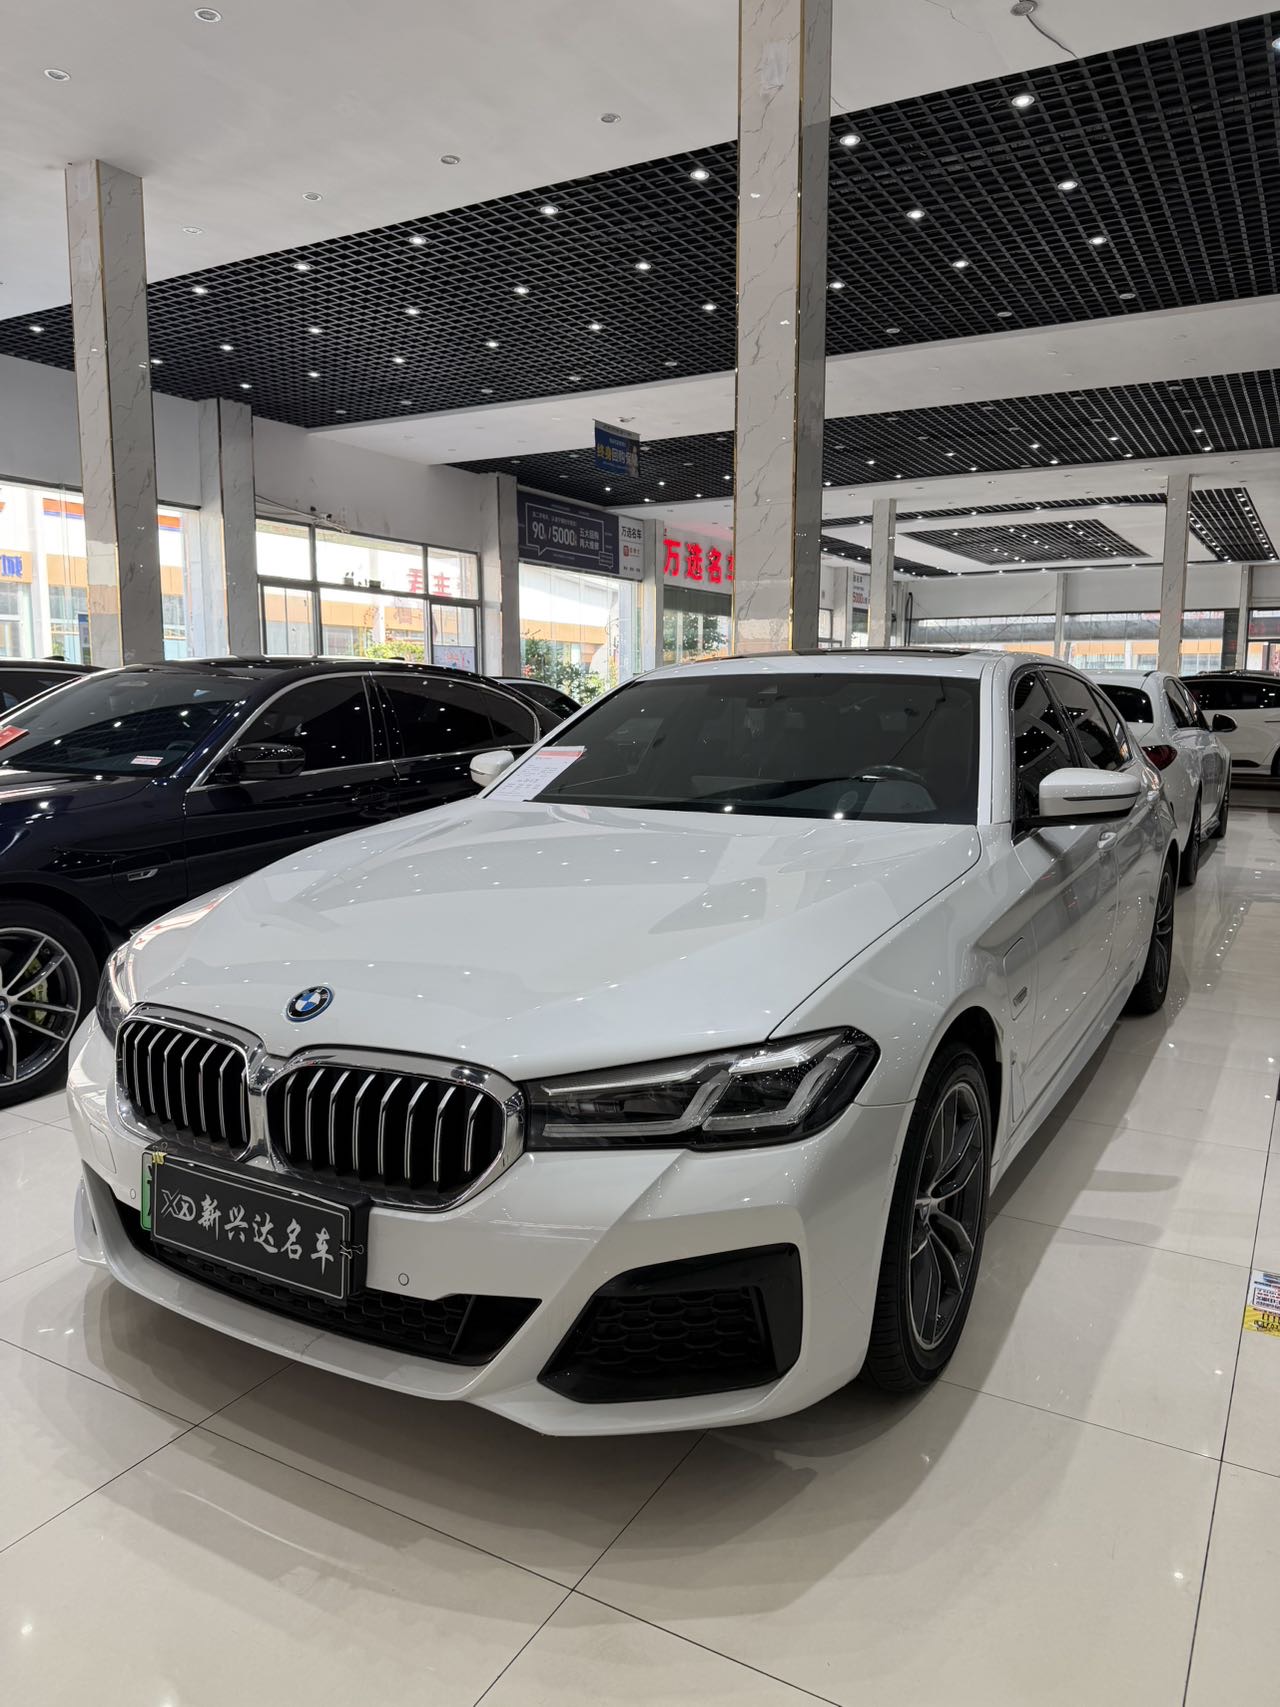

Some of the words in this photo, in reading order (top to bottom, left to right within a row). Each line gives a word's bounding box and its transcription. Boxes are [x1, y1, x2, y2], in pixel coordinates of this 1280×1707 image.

[197, 1193, 335, 1276] 新兴达名车
